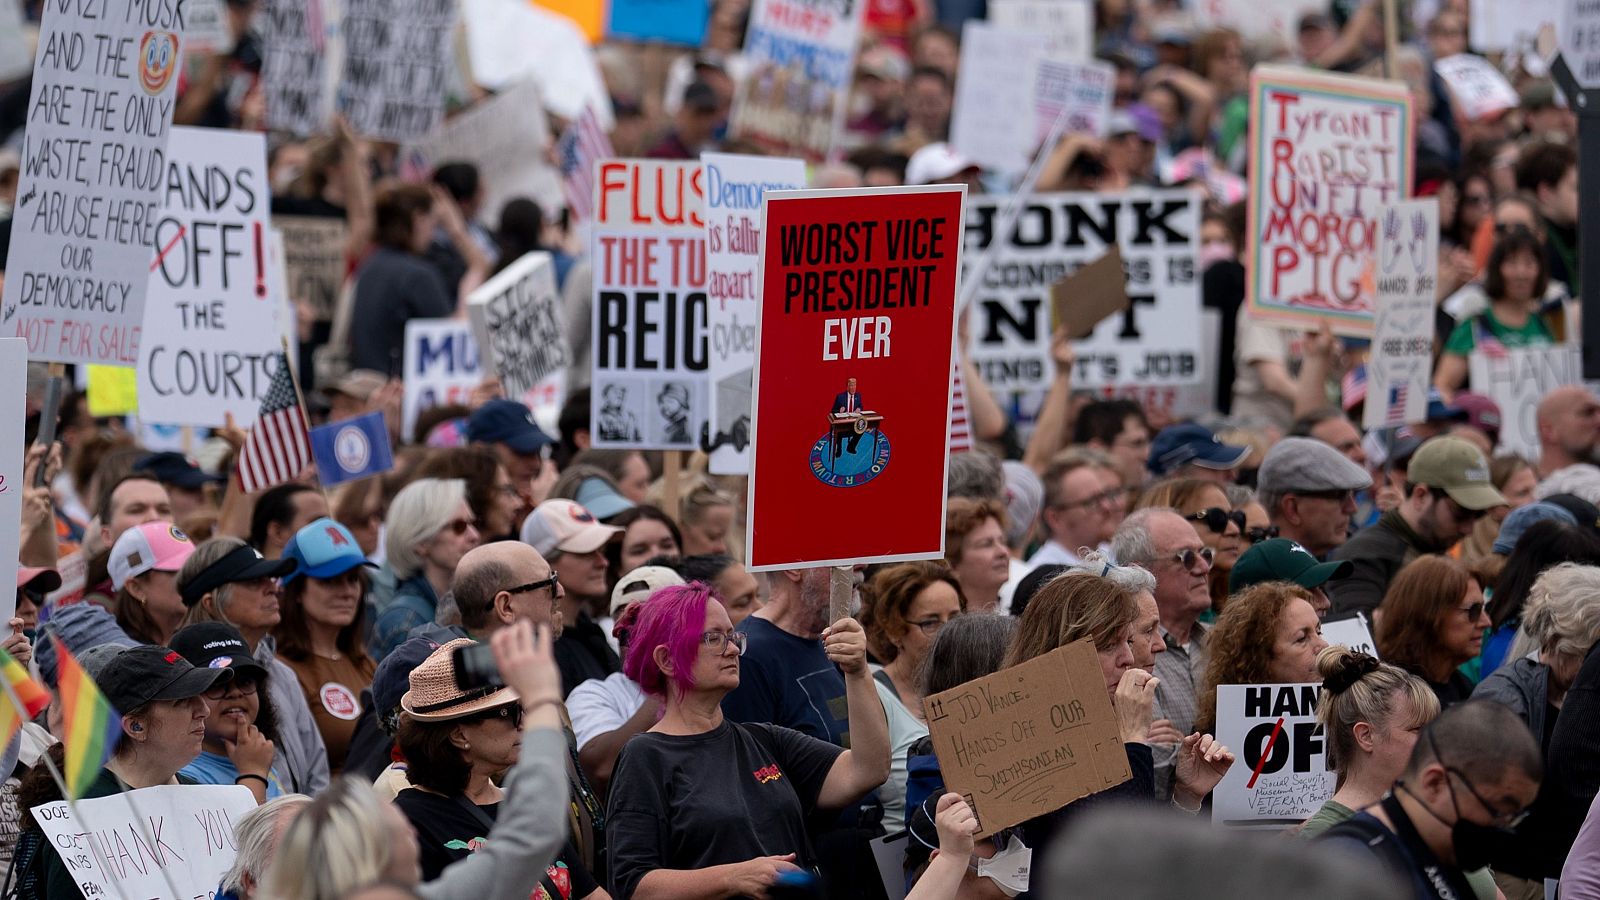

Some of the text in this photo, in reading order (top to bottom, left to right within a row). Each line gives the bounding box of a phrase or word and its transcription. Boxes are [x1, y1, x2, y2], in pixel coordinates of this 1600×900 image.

[41, 31, 134, 79] AND THE
[31, 84, 170, 137] ARE THE ONLY
[25, 135, 164, 192] WASTE, FRAUD
[164, 162, 256, 215] ANDS
[31, 191, 103, 240] ABUSE
[105, 200, 156, 247] HERE
[708, 220, 722, 255] is
[780, 217, 946, 267] WORST VICE
[962, 200, 1190, 249] HONK
[60, 244, 92, 272] OUR
[600, 237, 706, 288] THE TU
[1169, 257, 1195, 284] IS
[1272, 246, 1362, 304] PIG
[20, 271, 130, 313] DEMOCRACY
[709, 269, 754, 311] apart
[784, 265, 937, 315] PRESIDENT
[176, 301, 226, 330] THE
[598, 290, 708, 371] REIC
[712, 313, 756, 361] cybe
[822, 315, 892, 361] EVER
[982, 294, 1156, 343] NT
[16, 318, 142, 363] NOT FOR SALE
[1134, 353, 1195, 378] JOB
[203, 640, 226, 650] voting
[948, 691, 982, 725] JD
[1245, 685, 1322, 718] HAN
[951, 699, 1087, 768] HANDS OFF OUR
[1244, 721, 1330, 775] OF
[974, 744, 1075, 795] SMITHSONIAN
[1261, 777, 1290, 790] Social
[40, 805, 70, 821] DOE
[1248, 792, 1309, 809] VETERAN
[1258, 806, 1313, 816] Education
[66, 854, 92, 871] NPS
[74, 808, 238, 884] THANK YOU
